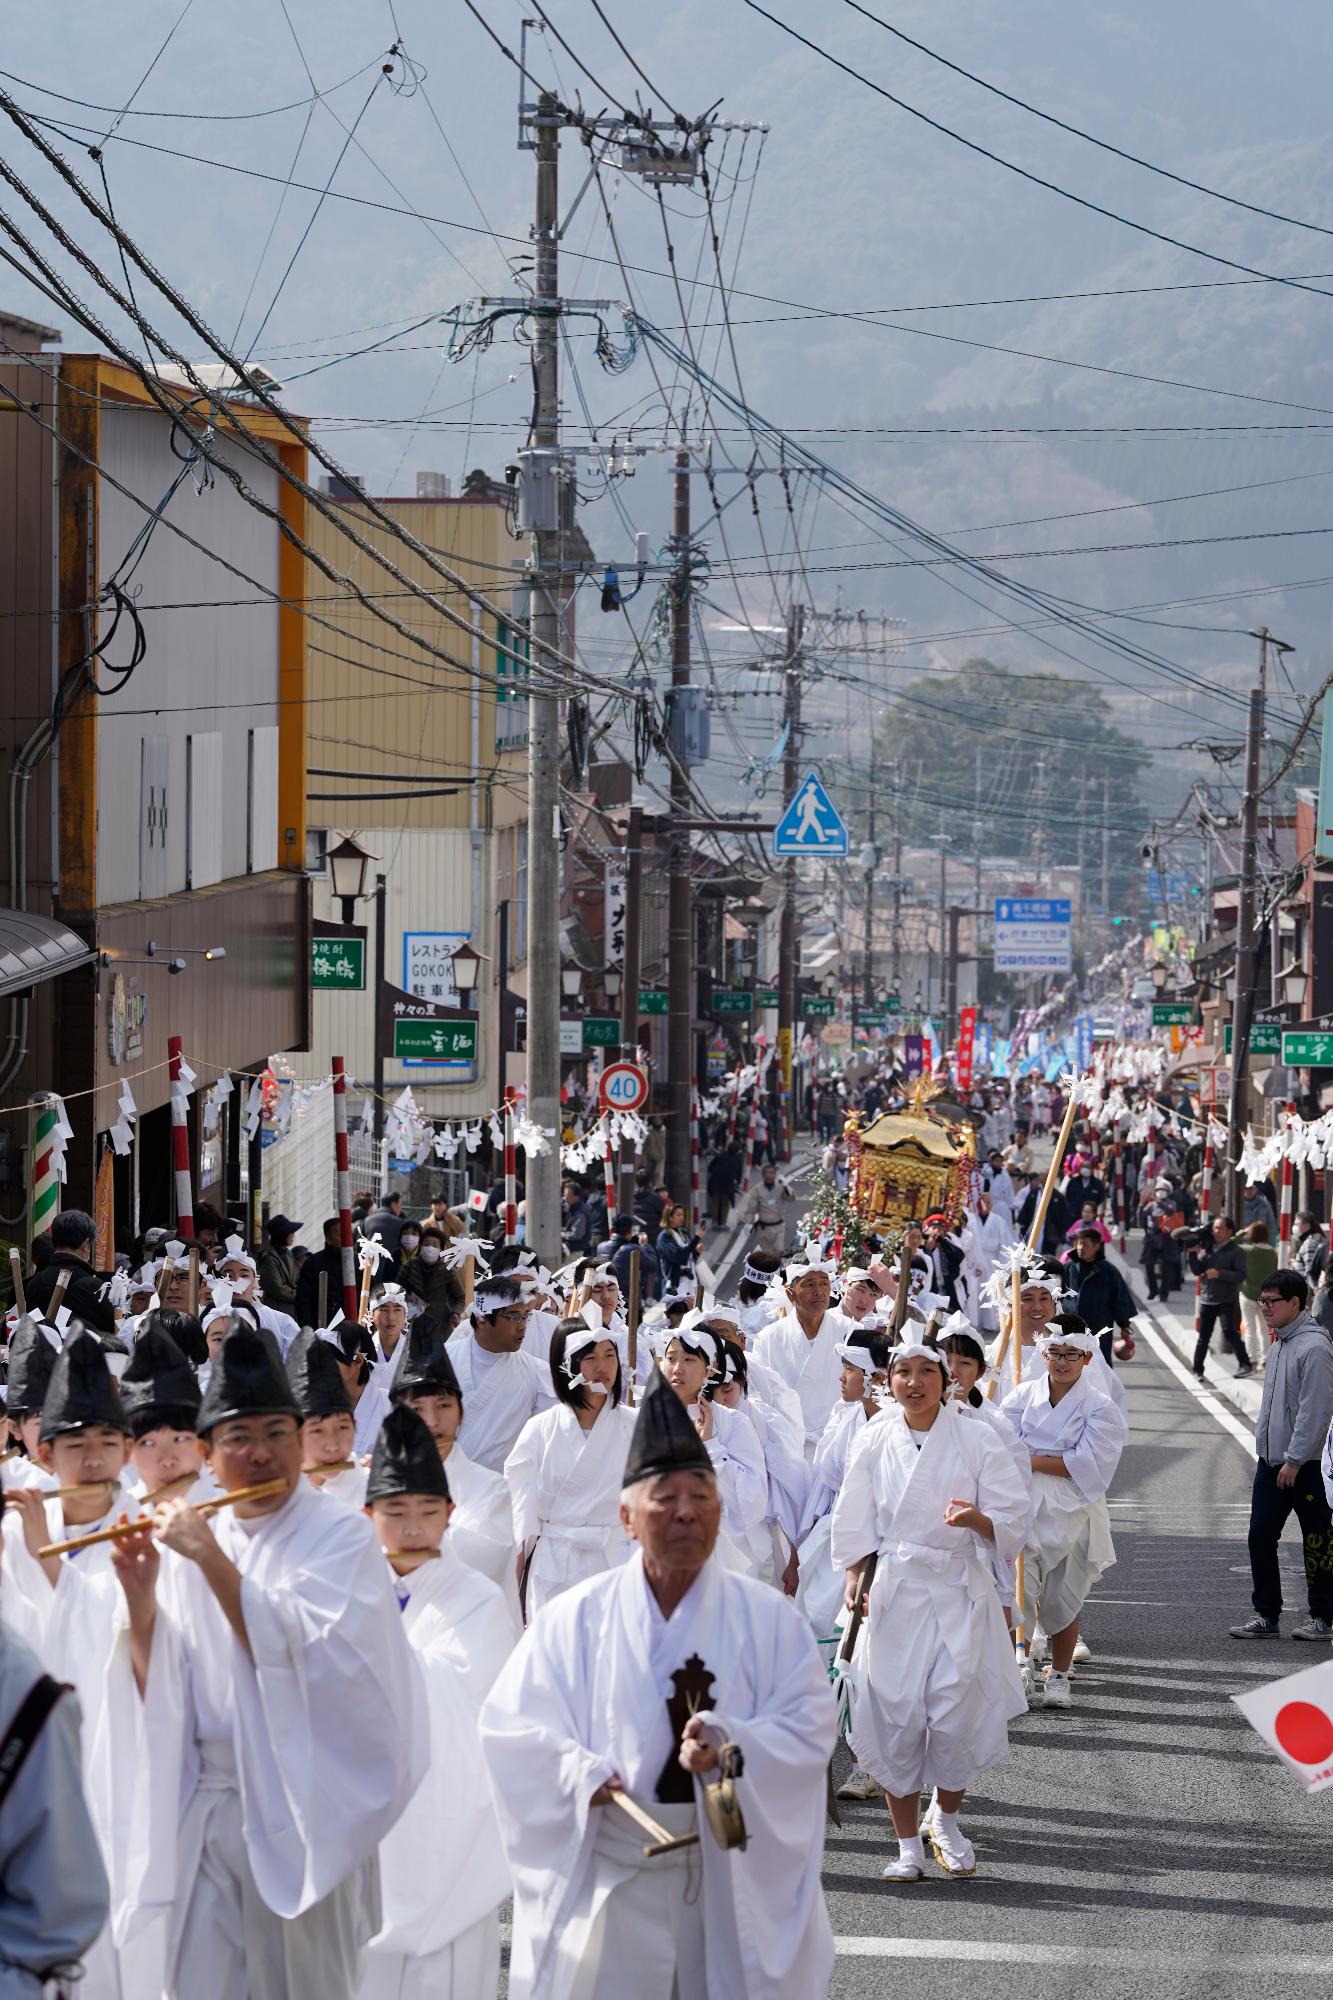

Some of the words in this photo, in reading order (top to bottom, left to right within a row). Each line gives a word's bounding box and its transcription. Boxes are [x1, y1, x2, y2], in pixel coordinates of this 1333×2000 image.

[393, 1001, 436, 1016] 神々の里
[610, 1077, 636, 1098] 40
